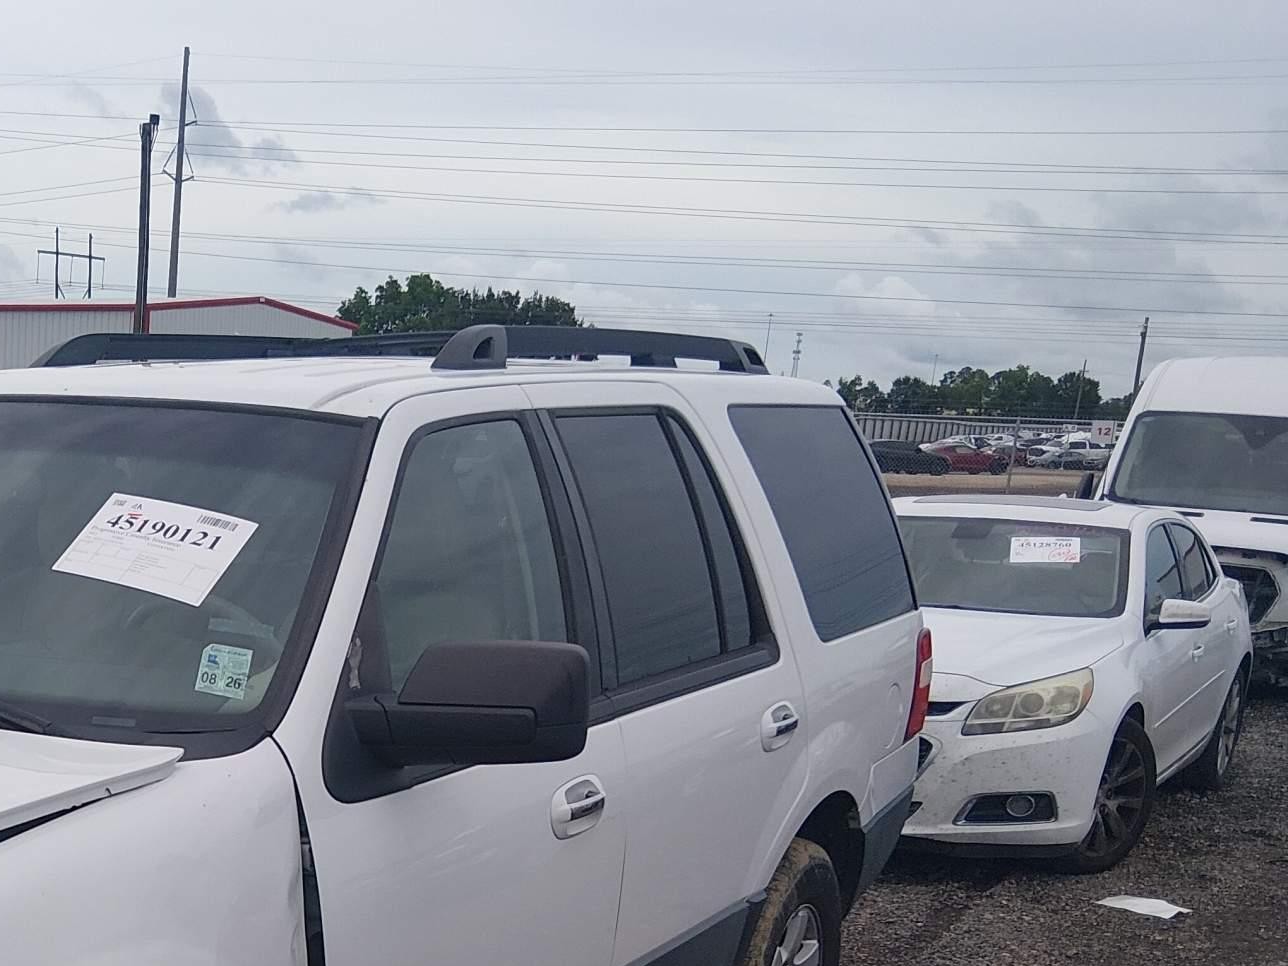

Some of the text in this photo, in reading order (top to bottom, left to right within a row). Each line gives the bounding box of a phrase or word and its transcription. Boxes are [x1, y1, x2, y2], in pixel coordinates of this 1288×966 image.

[1097, 427, 1112, 436] 12
[106, 513, 222, 551] 45190121
[201, 671, 242, 690] 08 26
